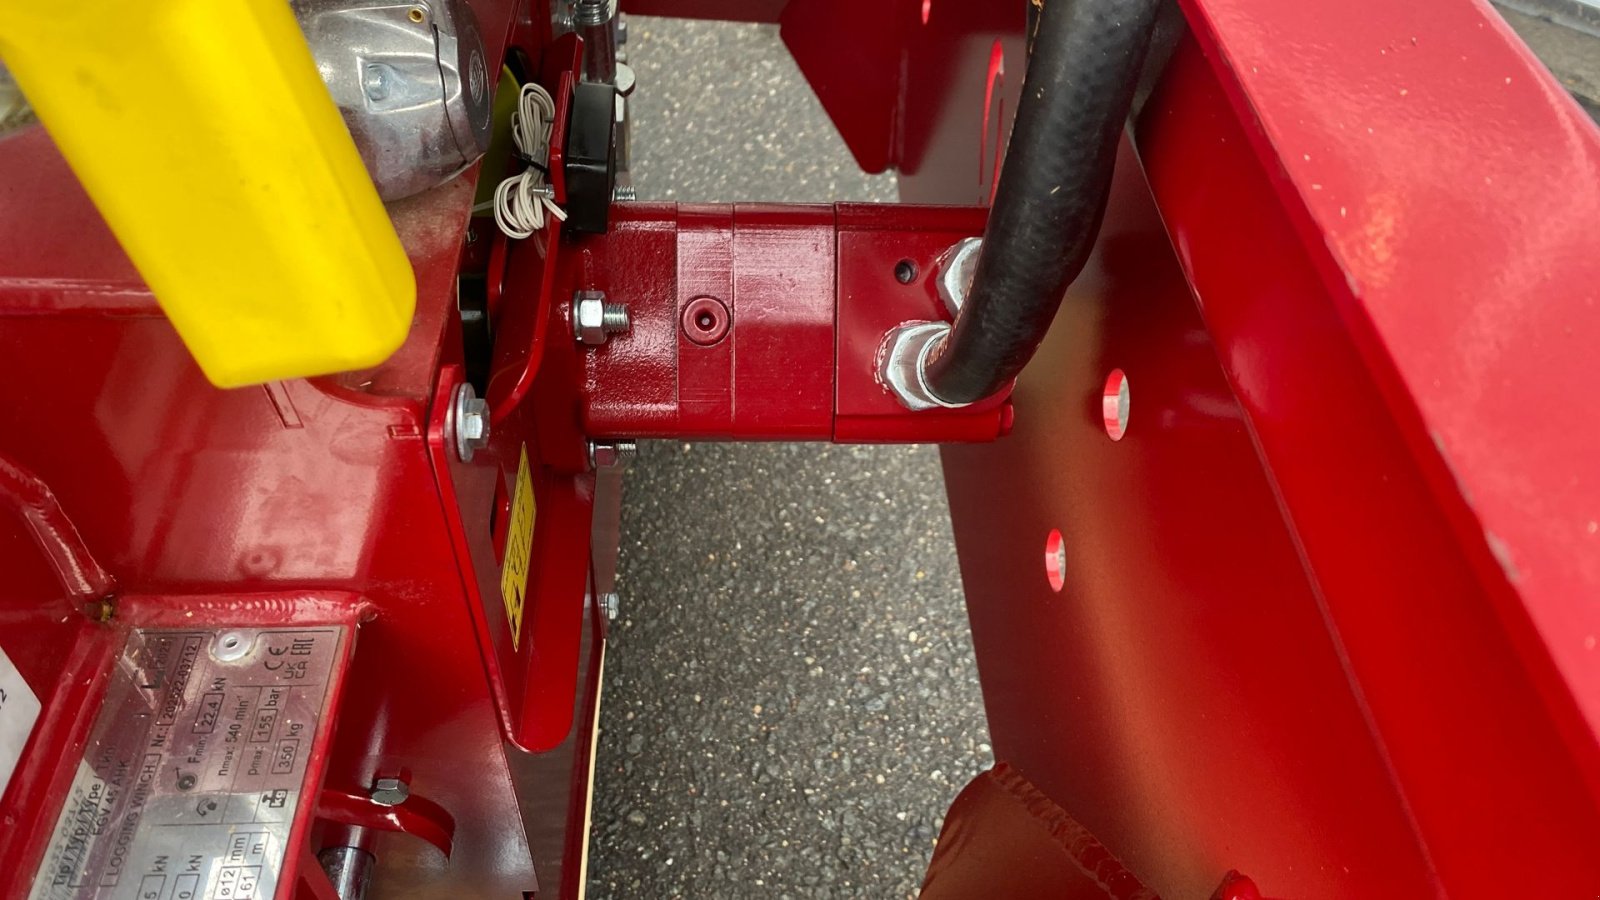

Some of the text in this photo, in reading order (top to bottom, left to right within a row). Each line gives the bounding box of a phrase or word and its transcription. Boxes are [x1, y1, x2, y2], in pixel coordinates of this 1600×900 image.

[201, 701, 220, 728] 22.4
[211, 677, 228, 692] kN
[265, 688, 281, 708] bar
[225, 722, 243, 744] 540
[257, 714, 274, 737] 155
[286, 723, 304, 738] kg
[278, 746, 295, 769] 350
[93, 807, 111, 836] EGV
[111, 760, 130, 788] AHK
[107, 764, 155, 877] LOGGING WINCH
[230, 836, 247, 862] mm
[252, 842, 264, 856] m
[152, 855, 170, 873] kN
[186, 854, 203, 873] kN
